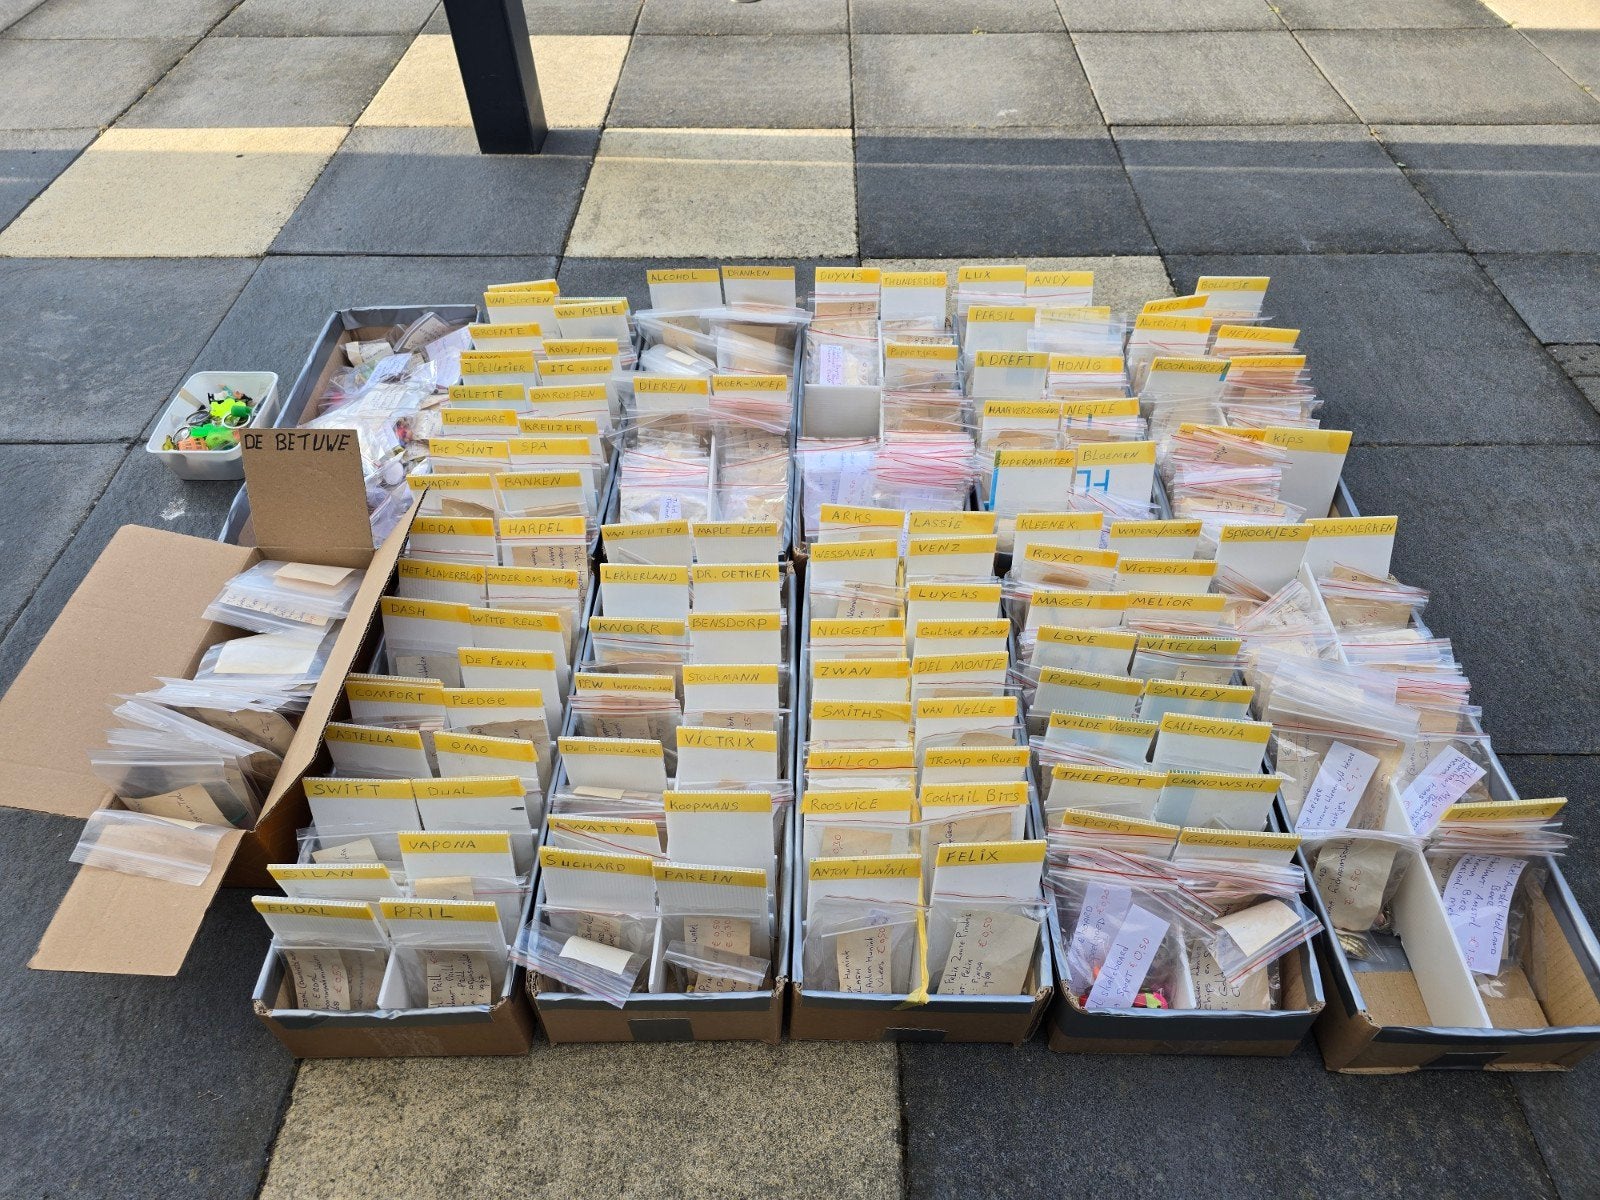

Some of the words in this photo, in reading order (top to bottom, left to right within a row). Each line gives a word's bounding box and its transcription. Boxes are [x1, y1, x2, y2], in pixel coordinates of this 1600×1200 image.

[650, 272, 699, 283] ALCOHOL
[965, 271, 991, 280] LUX
[1033, 275, 1070, 285] ANDY
[582, 304, 620, 316] MELLE
[988, 355, 1035, 367] DREFT
[1056, 359, 1102, 372] HONIG
[551, 363, 575, 373] ITC
[639, 382, 688, 393] DIEREN
[244, 433, 263, 450] DE
[276, 432, 351, 451] BETUWE
[521, 443, 548, 454] SPA
[504, 476, 562, 489] BANKEN
[831, 511, 872, 524] ARKS
[421, 523, 456, 534] LODA
[508, 522, 564, 534] HARPEL
[741, 526, 772, 534] LEAF
[918, 543, 961, 553] VENZ
[402, 569, 420, 580] HET
[604, 570, 678, 582] LEKKERLAND
[721, 570, 772, 580] OETKER
[390, 603, 427, 616] DASH
[597, 622, 662, 634] KNORR
[692, 617, 768, 630] BENSDORP
[1053, 632, 1098, 644] LOVE
[820, 665, 872, 676] ZWAN
[917, 660, 943, 673] DEL
[950, 658, 1005, 671] MONTE
[354, 689, 425, 702] COMFORT
[922, 705, 943, 714] VAN
[450, 741, 489, 754] OMO
[427, 787, 473, 797] DUAL
[1071, 816, 1132, 832] SPORT
[408, 840, 477, 851] VAPONA
[546, 854, 627, 872] SUCHARD
[813, 867, 849, 878] ANTON
[267, 902, 331, 916] ERDAL
